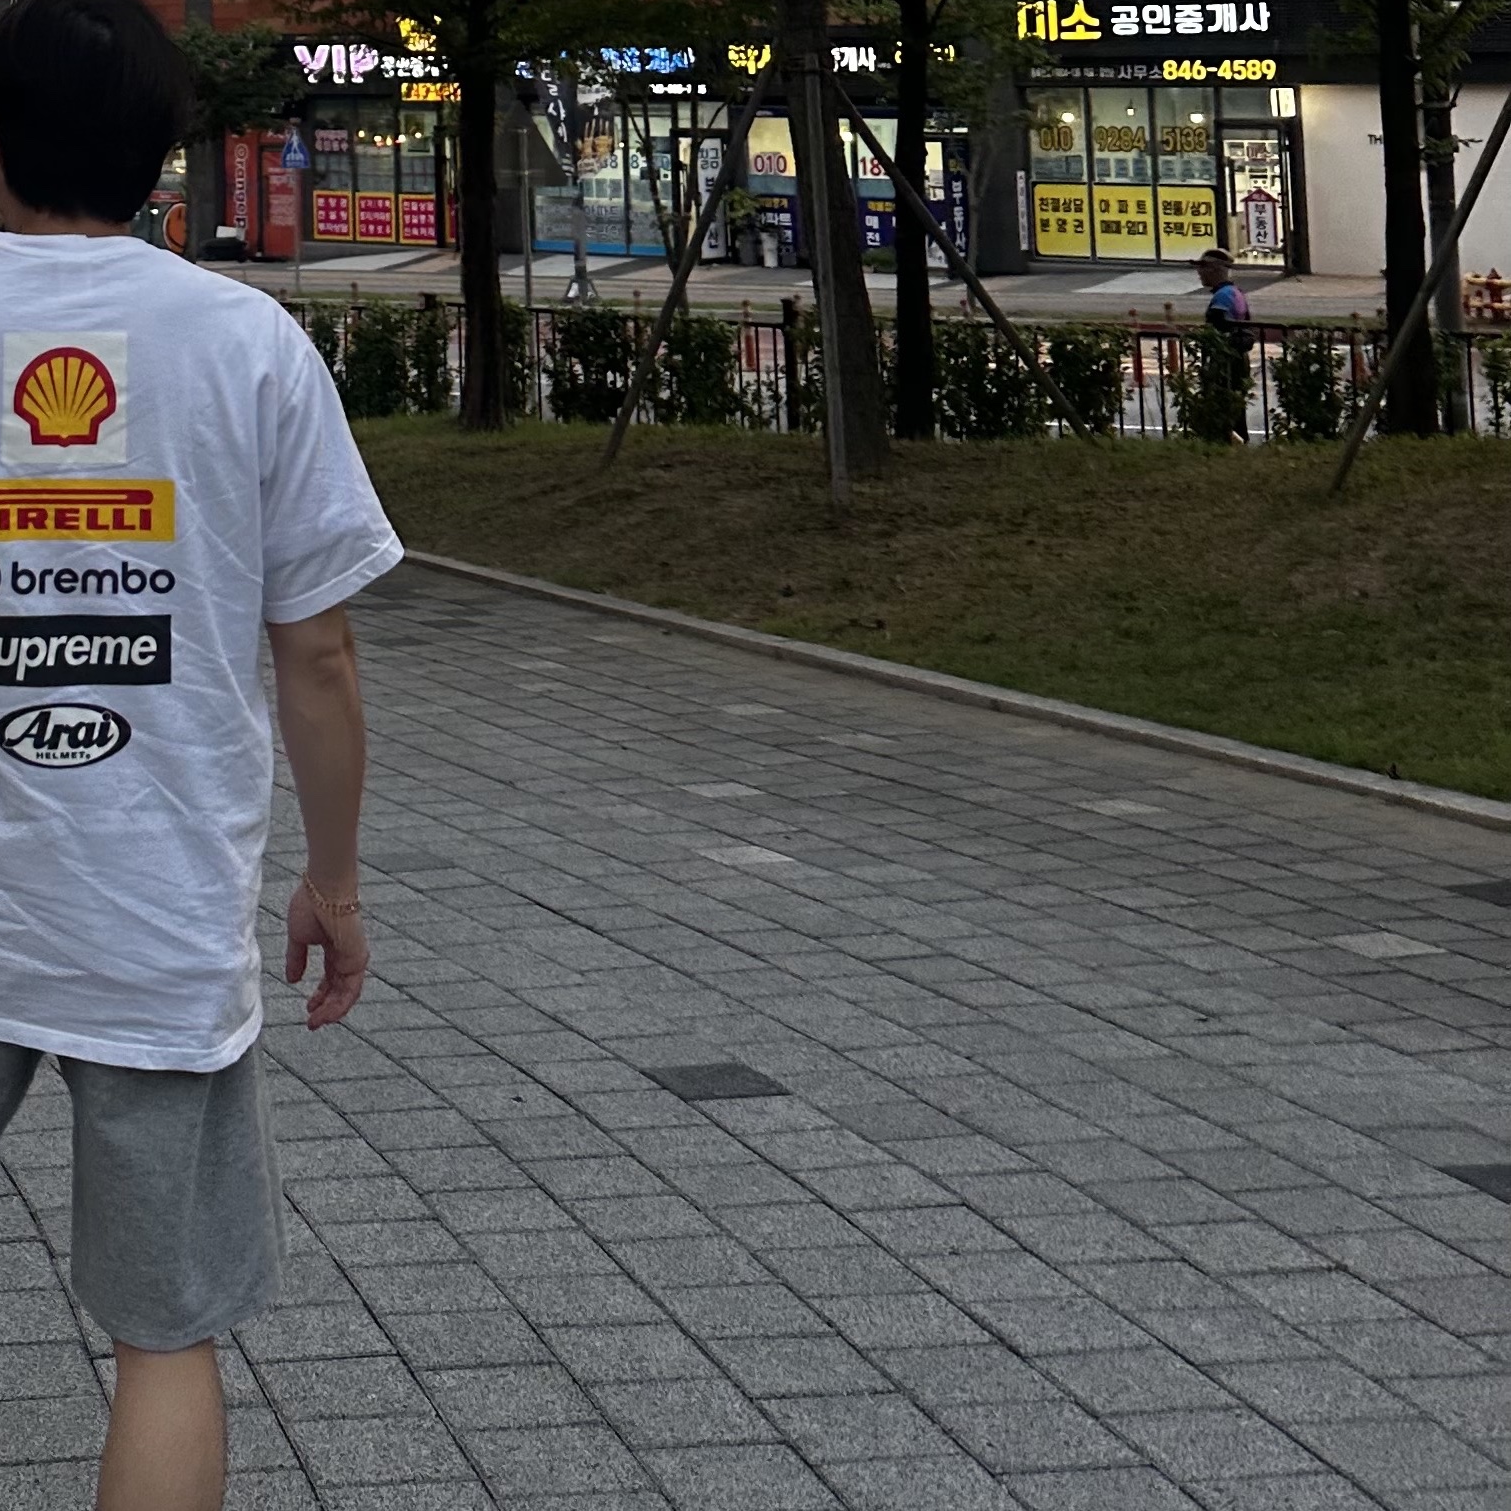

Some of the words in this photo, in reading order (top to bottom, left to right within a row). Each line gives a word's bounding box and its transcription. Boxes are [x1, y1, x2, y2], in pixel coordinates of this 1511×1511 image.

[1017, 0, 1102, 41] 미소
[1111, 2, 1270, 35] 공인중개사
[293, 44, 379, 83] VIP
[1118, 64, 1162, 80] 사무소
[1162, 60, 1277, 80] 846-4589
[1039, 125, 1074, 151] 010
[1094, 126, 1148, 152] 9284
[1161, 126, 1210, 153] 5133
[753, 154, 788, 174] 010
[1039, 197, 1084, 213] 친절상담
[1254, 203, 1269, 244] 부동산
[11, 561, 175, 595] brembo
[3, 711, 115, 749] Arai
[36, 752, 85, 760] HELMET
